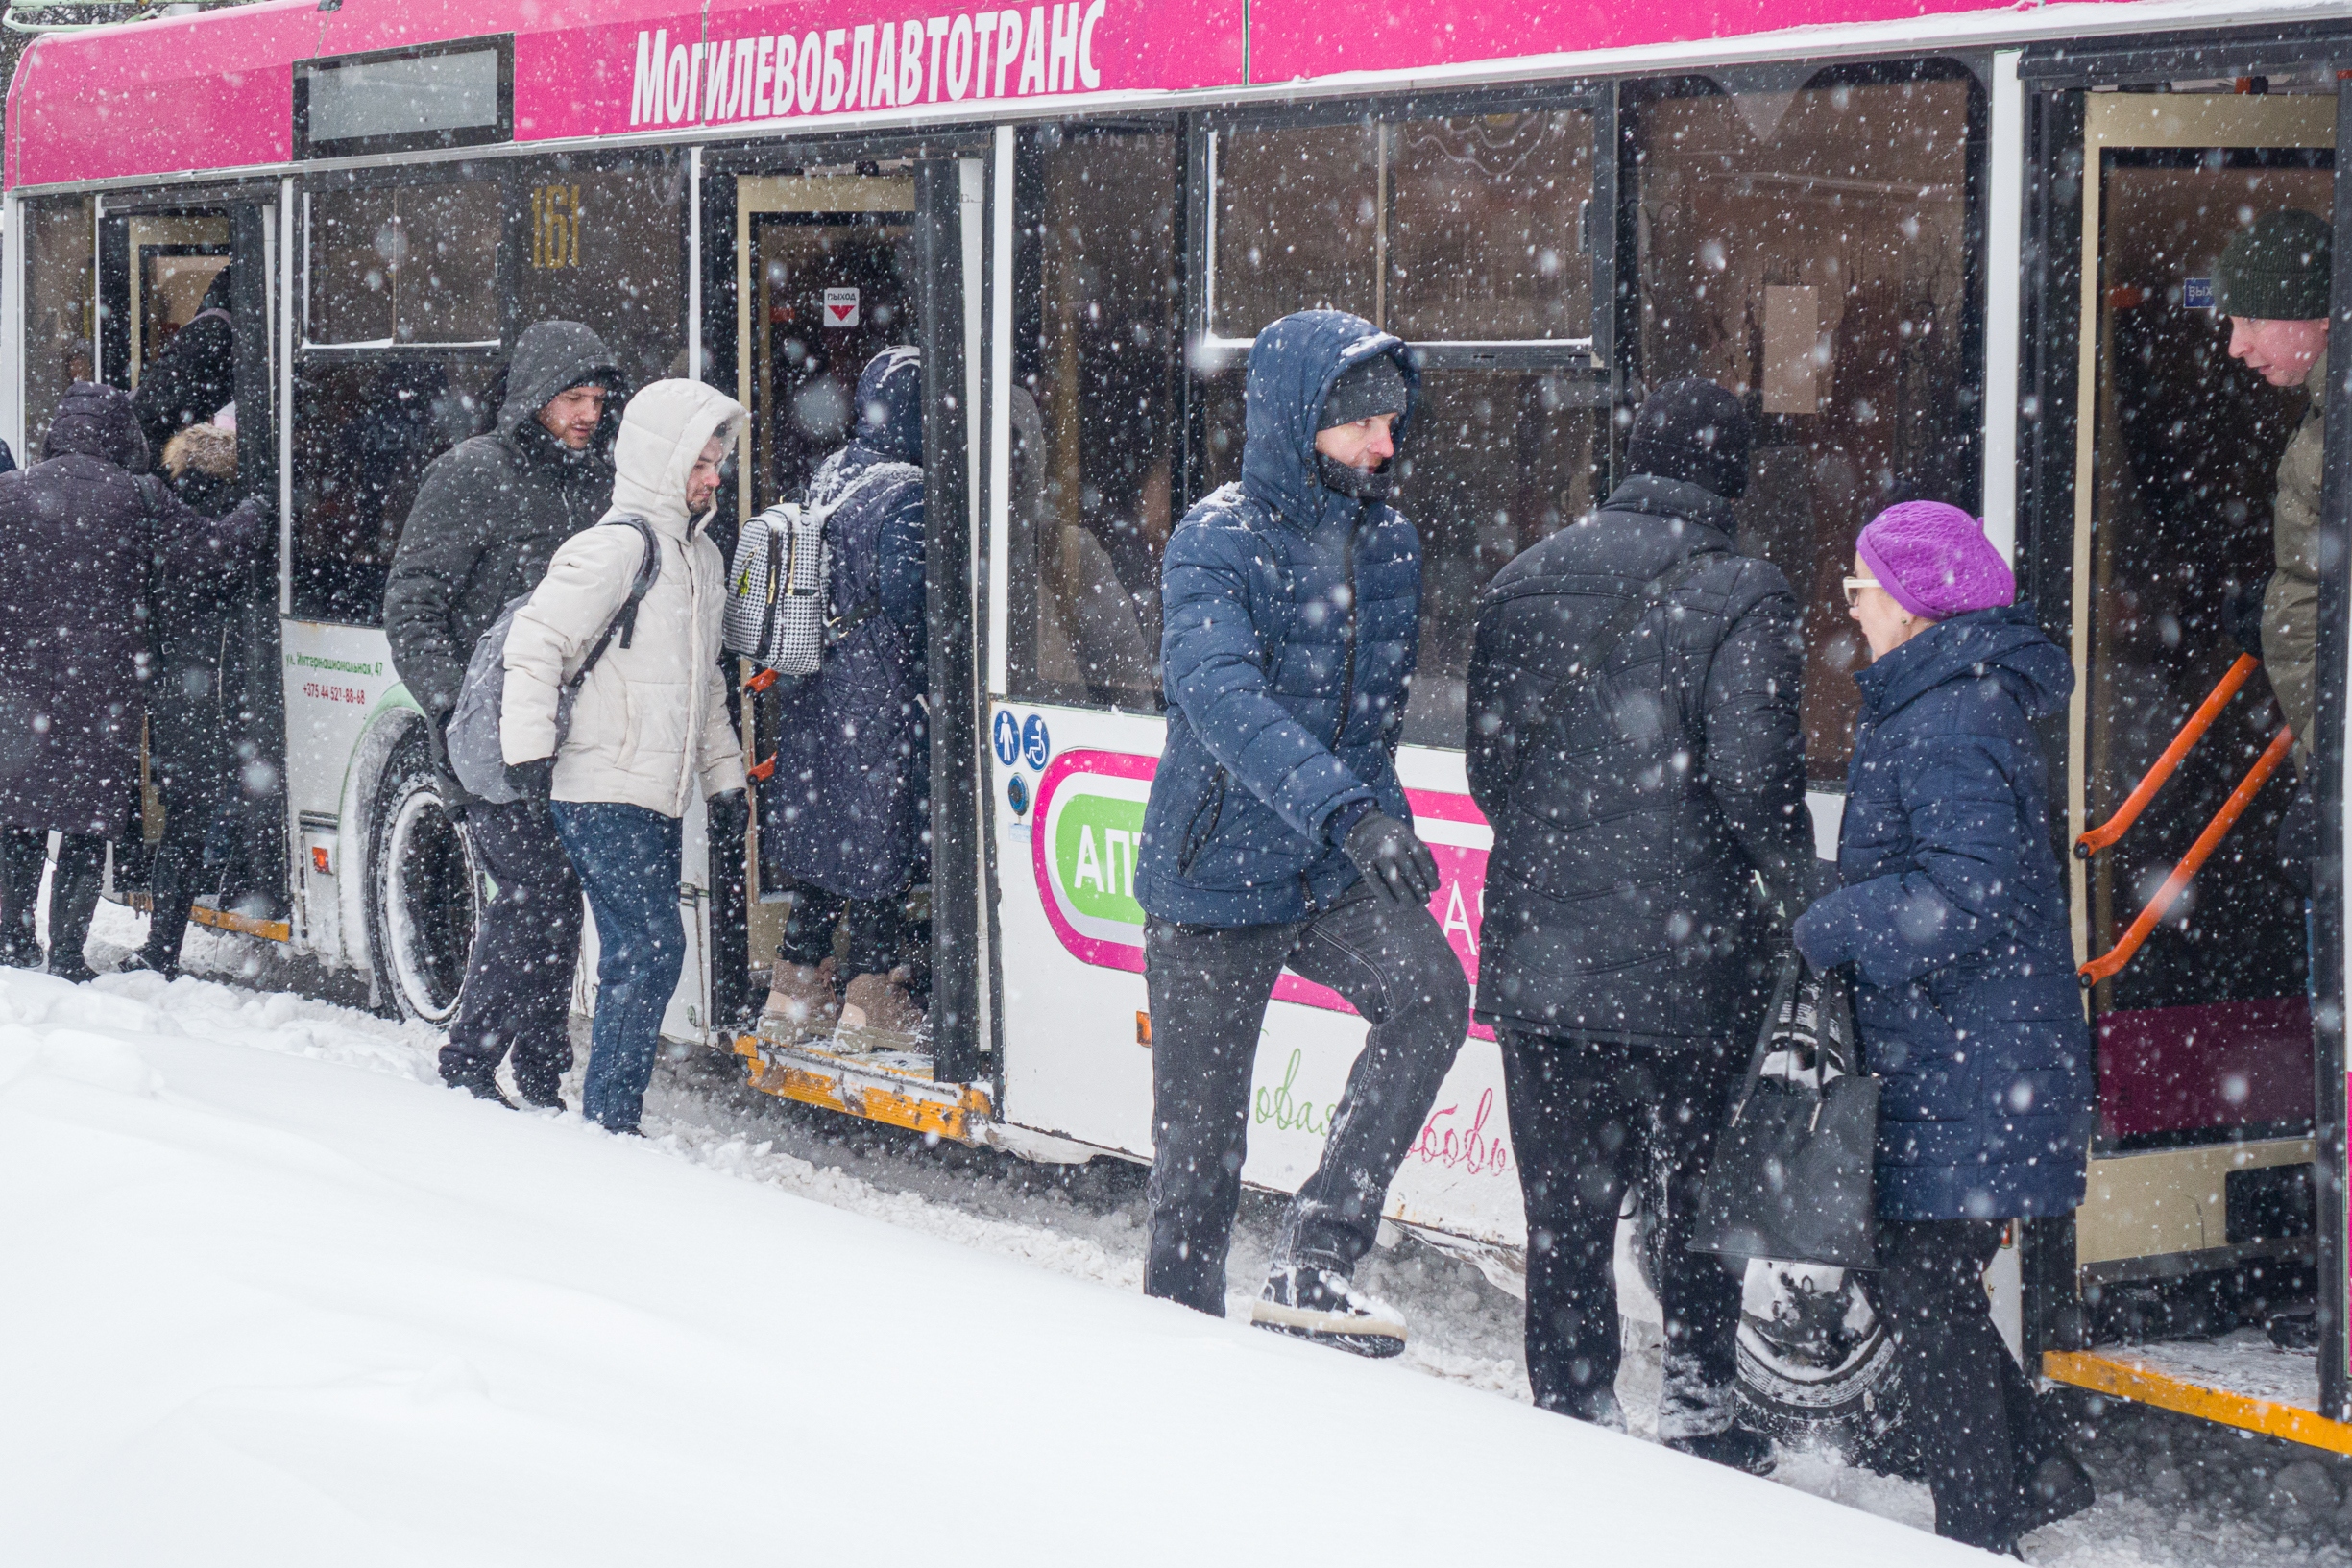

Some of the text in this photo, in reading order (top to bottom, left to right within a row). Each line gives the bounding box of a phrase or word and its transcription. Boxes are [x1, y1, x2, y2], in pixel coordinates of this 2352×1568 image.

[531, 184, 580, 269] 161
[2188, 285, 2213, 297] ВЫХ
[285, 654, 295, 667] ул.
[375, 661, 383, 676] 47
[303, 683, 365, 704] +375 44 521-88-68
[1255, 1047, 1516, 1177] ова бовь
